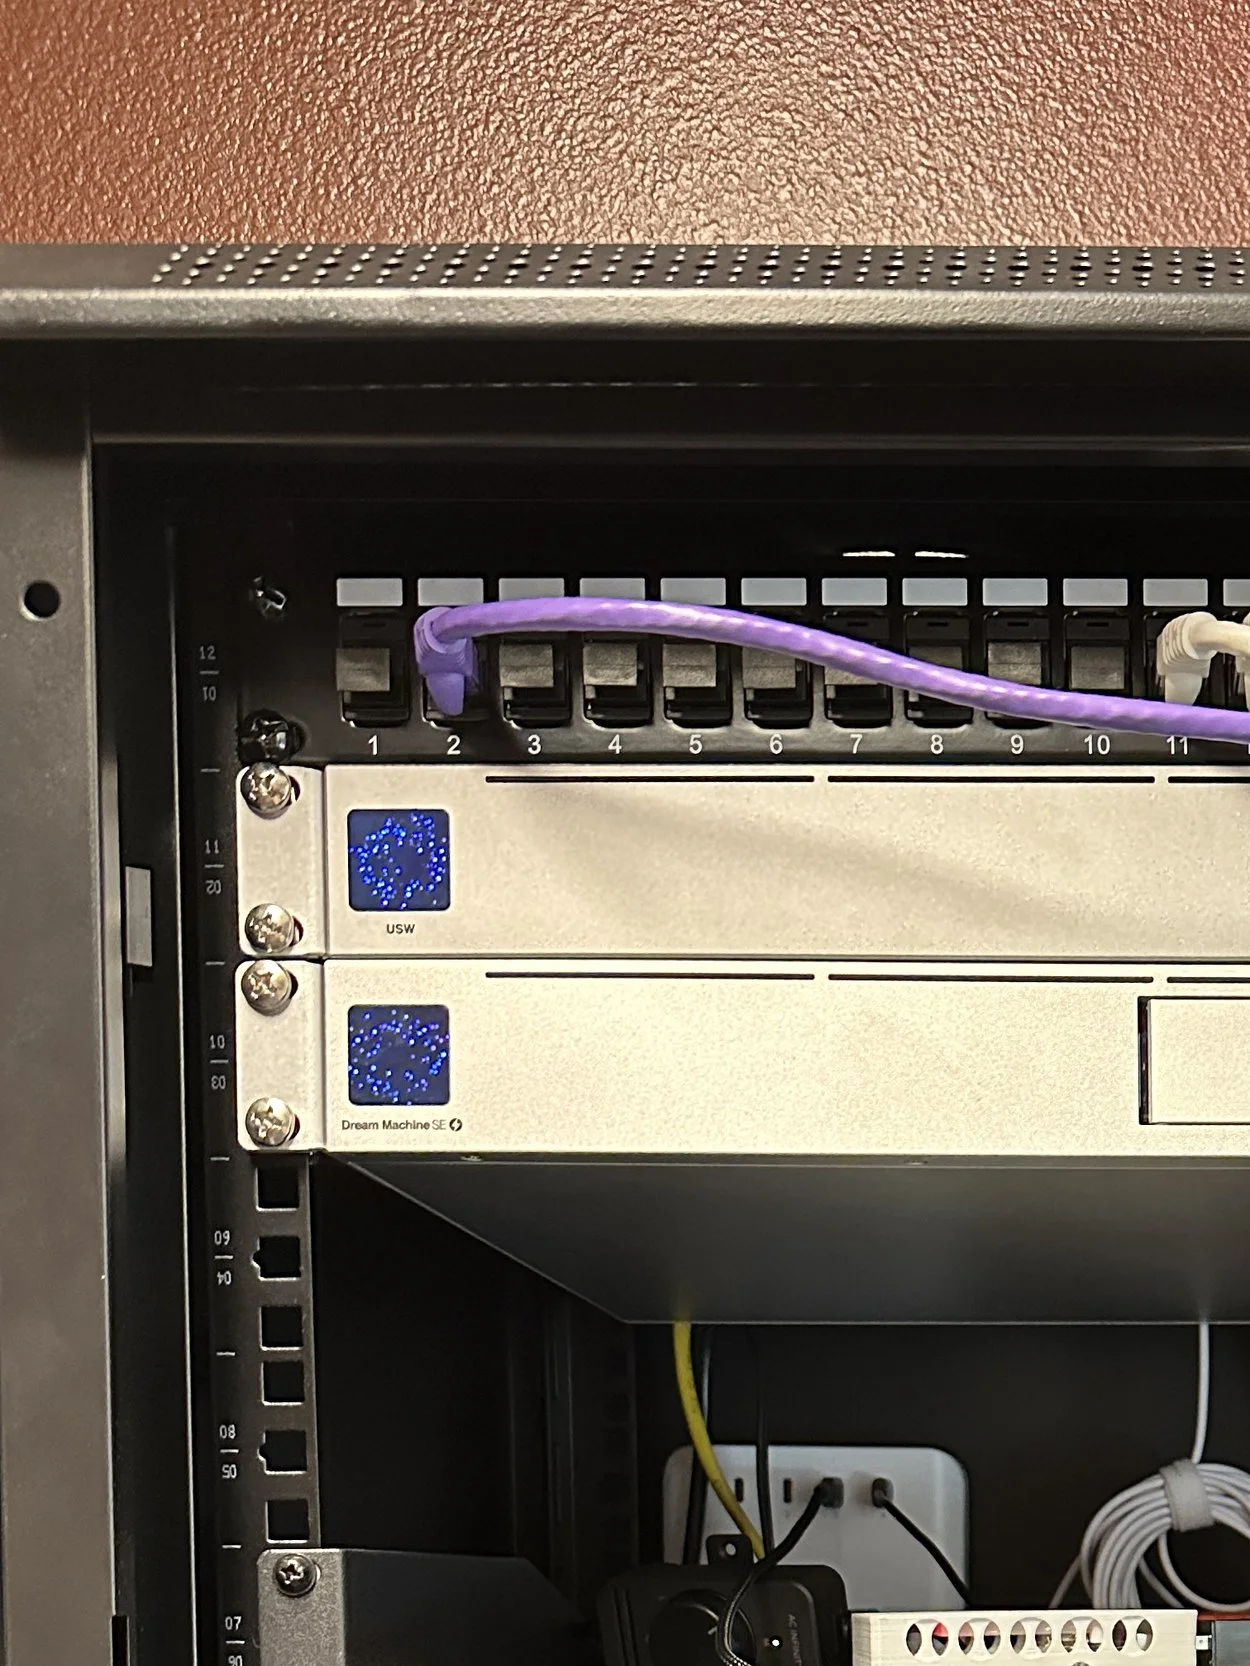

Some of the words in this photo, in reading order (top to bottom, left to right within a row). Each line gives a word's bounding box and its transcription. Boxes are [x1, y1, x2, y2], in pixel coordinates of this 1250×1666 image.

[199, 645, 216, 661] 12
[367, 735, 378, 756] 1
[446, 734, 461, 756] 2
[527, 734, 542, 755] 3
[607, 734, 623, 755] 4
[689, 734, 703, 755] 5
[769, 734, 783, 755] 6
[850, 734, 863, 755] 7
[930, 734, 944, 755] 8
[1010, 734, 1024, 755] 9
[1084, 734, 1111, 755] 10
[1166, 735, 1189, 755] 11
[205, 839, 220, 854] 11
[386, 923, 416, 935] USW
[209, 1034, 225, 1049] 10
[341, 1119, 379, 1131] Dream
[382, 1119, 430, 1131] Machine
[431, 1119, 447, 1131] SE
[214, 1230, 230, 1246] 09
[219, 1424, 236, 1440] 08
[225, 1616, 242, 1630] 07
